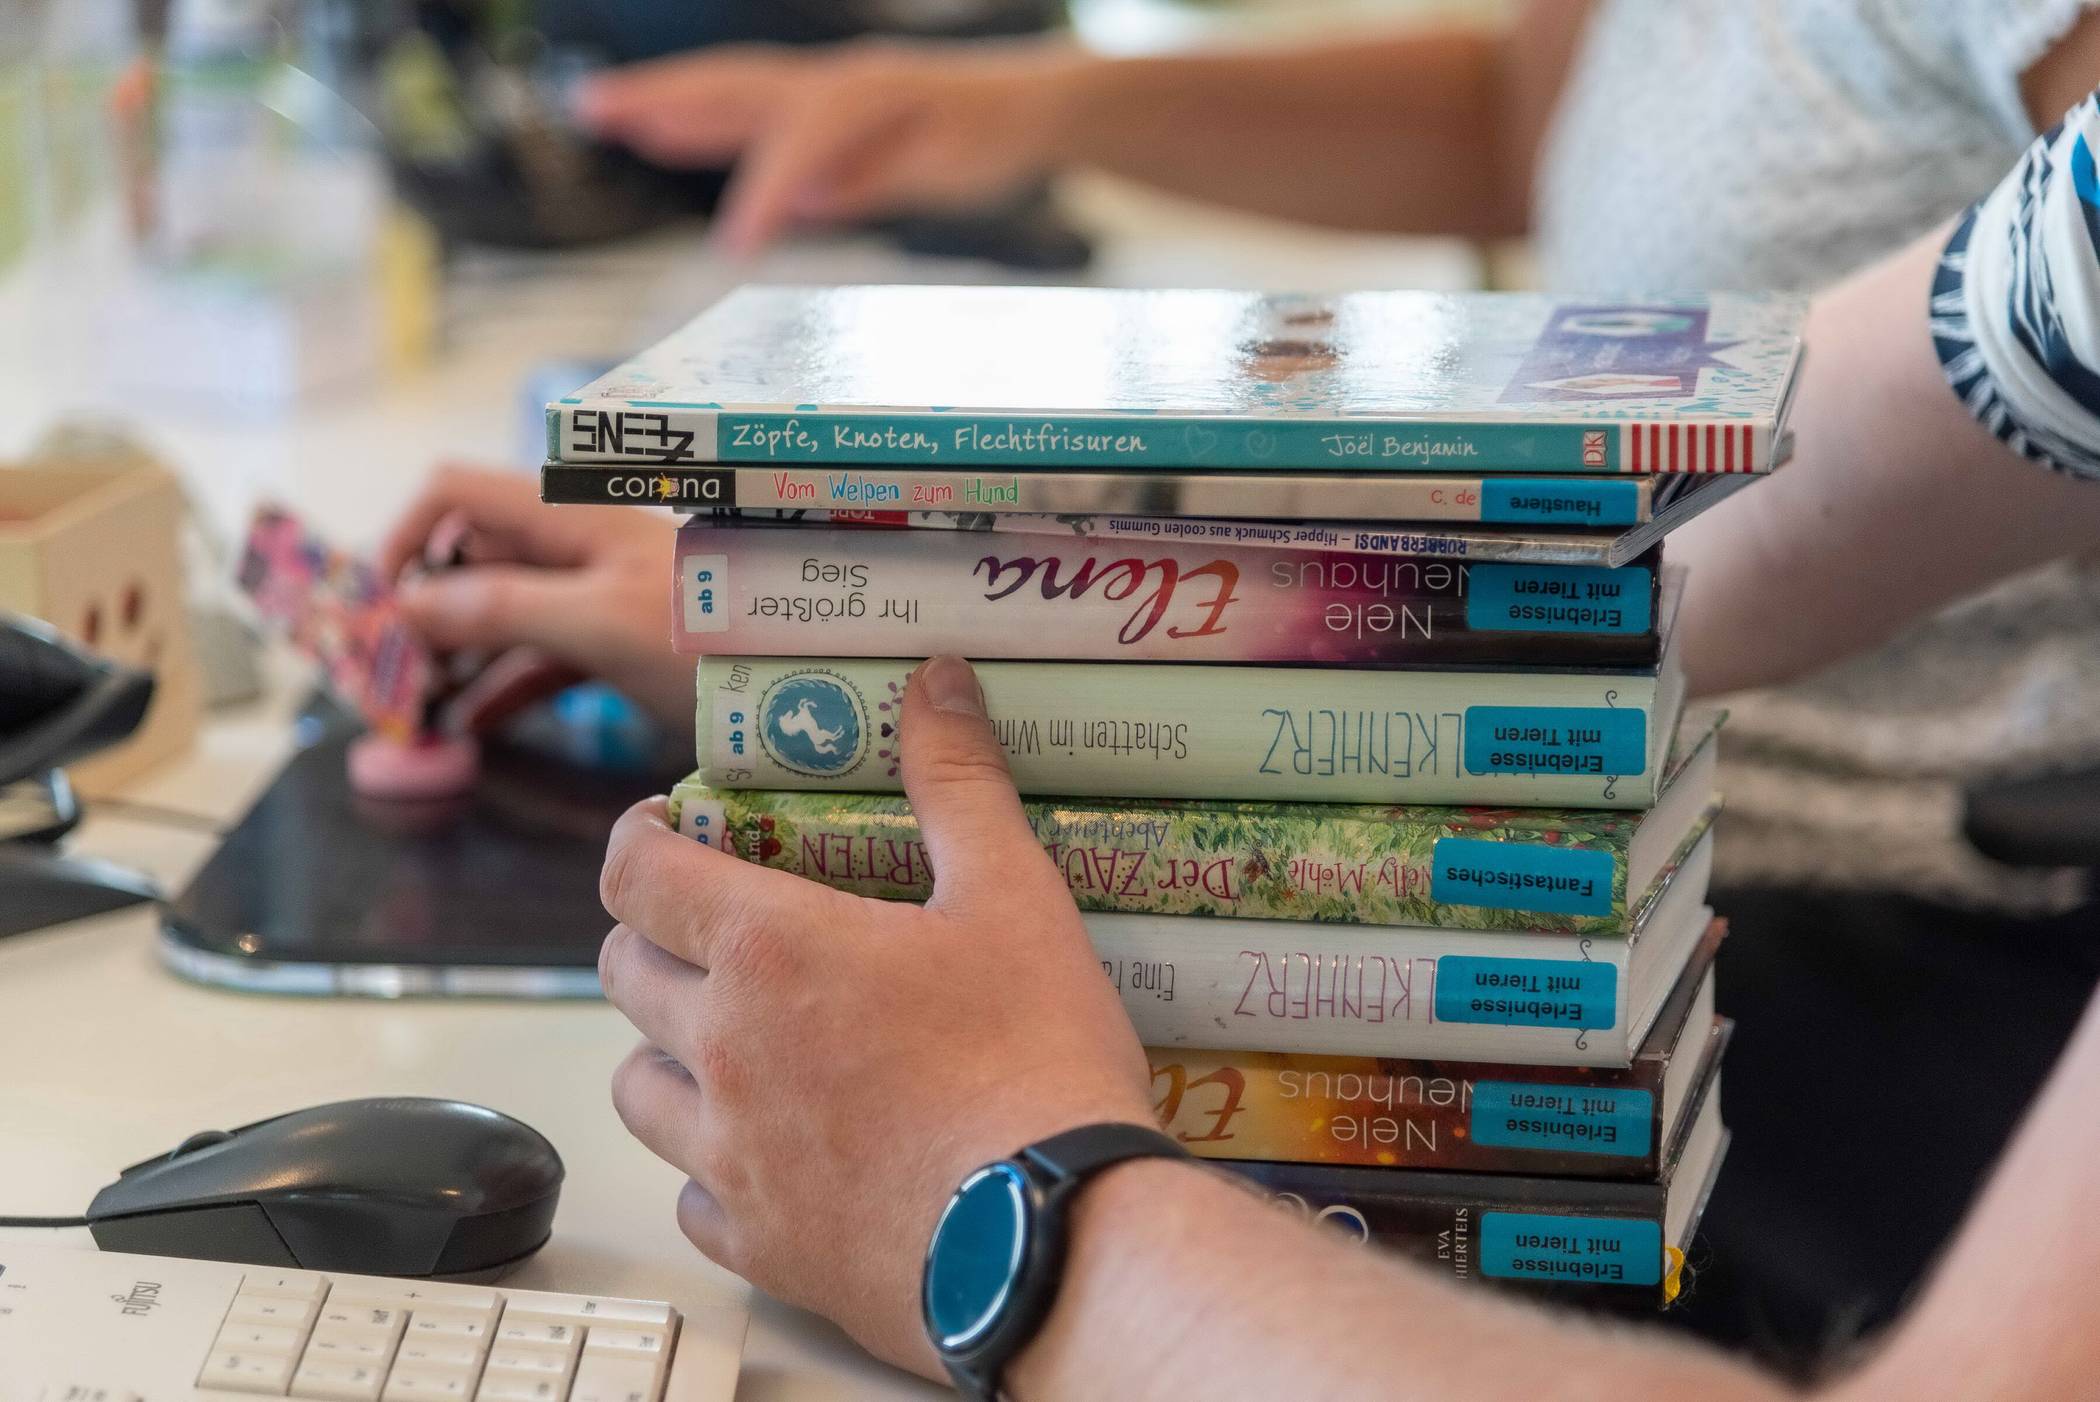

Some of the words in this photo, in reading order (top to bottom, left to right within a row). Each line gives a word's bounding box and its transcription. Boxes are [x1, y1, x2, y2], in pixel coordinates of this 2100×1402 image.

[732, 419, 818, 456] Zöpfe,
[834, 425, 939, 455] Knoten,
[955, 423, 1147, 451] Flechtfrisuren
[1322, 433, 1375, 457] Joël
[1381, 434, 1479, 465] Benjamin
[1583, 431, 1606, 466] DK
[773, 471, 815, 500] Vom
[828, 472, 900, 507] Welpen
[913, 484, 953, 504] zum
[963, 476, 1019, 505] Hund
[1431, 489, 1447, 506] C.
[1455, 489, 1477, 506] de
[1510, 496, 1601, 516] Haustiere
[1109, 519, 1160, 536] Gummis
[1164, 522, 1206, 538] coolen
[1209, 526, 1231, 538] aus
[1235, 527, 1292, 545] Schmuck
[1294, 527, 1338, 546] Hipper
[1355, 533, 1467, 555] RUBBERBANDS!
[697, 570, 713, 583] 9
[801, 558, 870, 588] Sieg
[697, 588, 713, 614] ab
[973, 556, 1240, 645] Elena
[1514, 579, 1580, 600] Tieren
[1587, 582, 1620, 600] mit
[747, 592, 866, 622] größter
[878, 599, 918, 623] Ihr
[1509, 604, 1621, 627] Erlebnisse
[1325, 603, 1432, 640] Nele
[729, 711, 744, 725] 9
[729, 731, 744, 755] ab
[1050, 719, 1074, 756] im
[1084, 720, 1188, 760] Schatten
[1259, 709, 1492, 780] LKENHERZ
[1494, 726, 1561, 746] Tieren
[1568, 729, 1601, 747] mit
[1490, 751, 1603, 772] Erlebnisse
[695, 814, 709, 827] 9
[1049, 819, 1171, 849] Abenteuer
[747, 829, 761, 864] and
[1158, 857, 1241, 901] Der
[1288, 858, 1367, 896] Möhle
[1447, 867, 1593, 897] Fantastisches
[1132, 961, 1175, 1001] Eine
[1475, 973, 1541, 992] Tieren
[1547, 976, 1580, 993] mit
[1471, 998, 1582, 1021] Erlebnisse
[1510, 1093, 1574, 1115] Tieren
[1583, 1099, 1616, 1116] mit
[1331, 1115, 1436, 1151] Nele
[1506, 1119, 1617, 1142] Erlebnisse
[1438, 1230, 1450, 1259] EVA
[1456, 1207, 1468, 1280] HIERTEIS
[1516, 1234, 1581, 1254] Tieren
[1587, 1237, 1620, 1255] mit
[1512, 1258, 1624, 1279] Erlebnisse
[121, 1281, 163, 1317] FUJITSU
